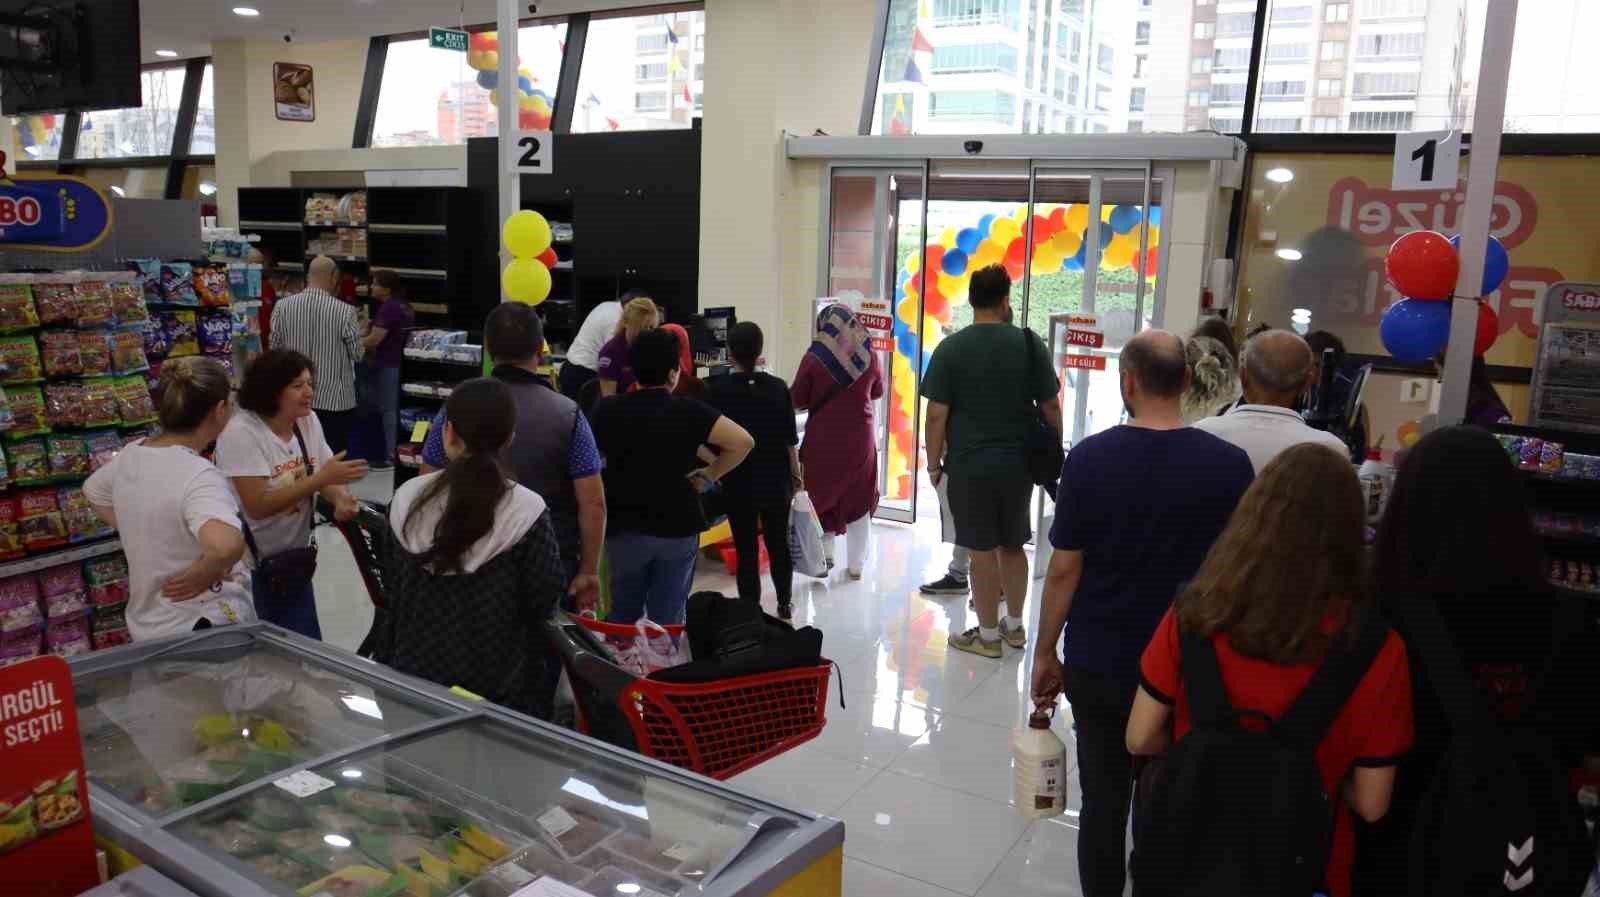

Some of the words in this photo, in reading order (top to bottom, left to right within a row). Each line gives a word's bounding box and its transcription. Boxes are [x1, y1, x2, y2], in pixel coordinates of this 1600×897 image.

[446, 32, 465, 41] EXIT
[518, 137, 540, 167] 2
[1412, 139, 1436, 181] 1
[0, 680, 62, 722] RGÜL
[4, 709, 63, 746] SEÇTİ!
